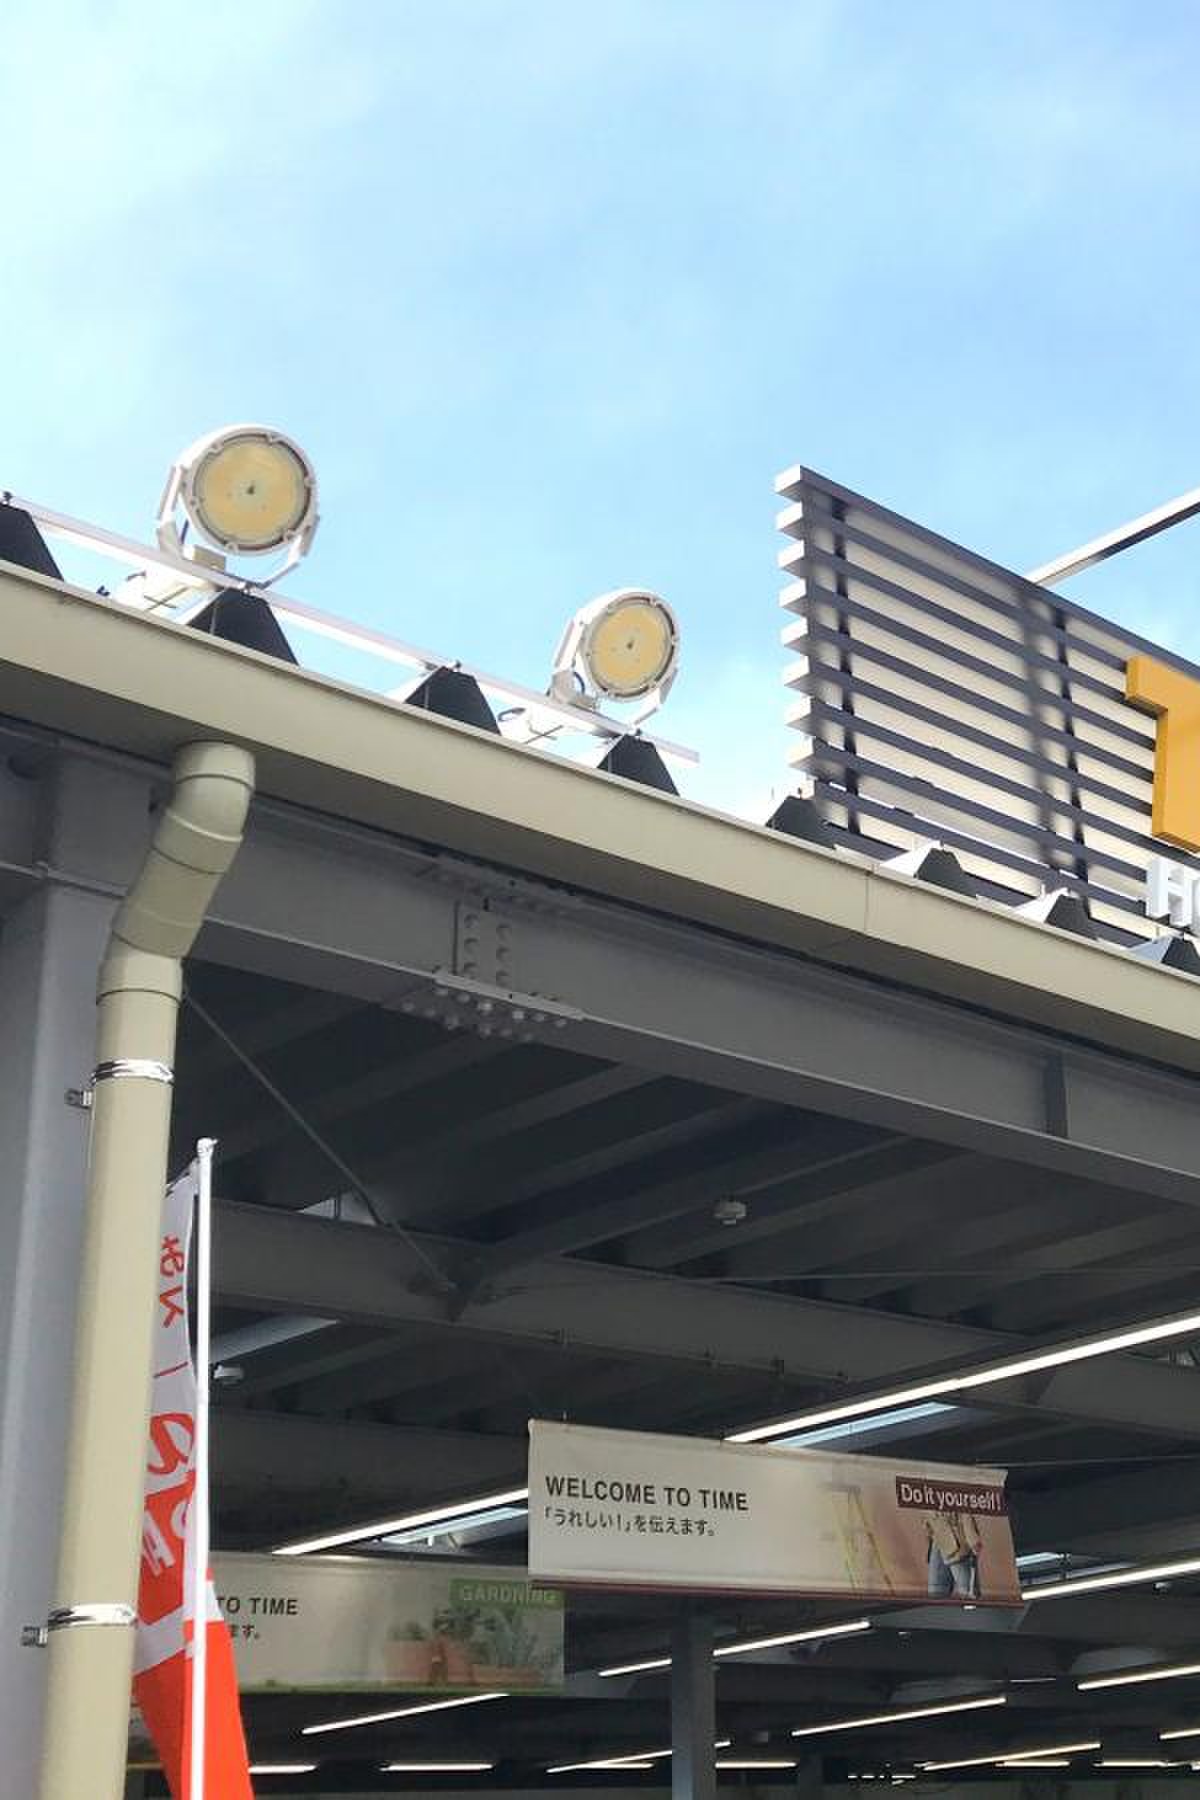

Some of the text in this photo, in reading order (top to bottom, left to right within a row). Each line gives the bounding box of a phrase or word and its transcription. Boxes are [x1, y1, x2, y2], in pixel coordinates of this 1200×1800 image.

[545, 1475, 750, 1511] WELCOME TO TIME
[249, 1597, 299, 1615] TIME
